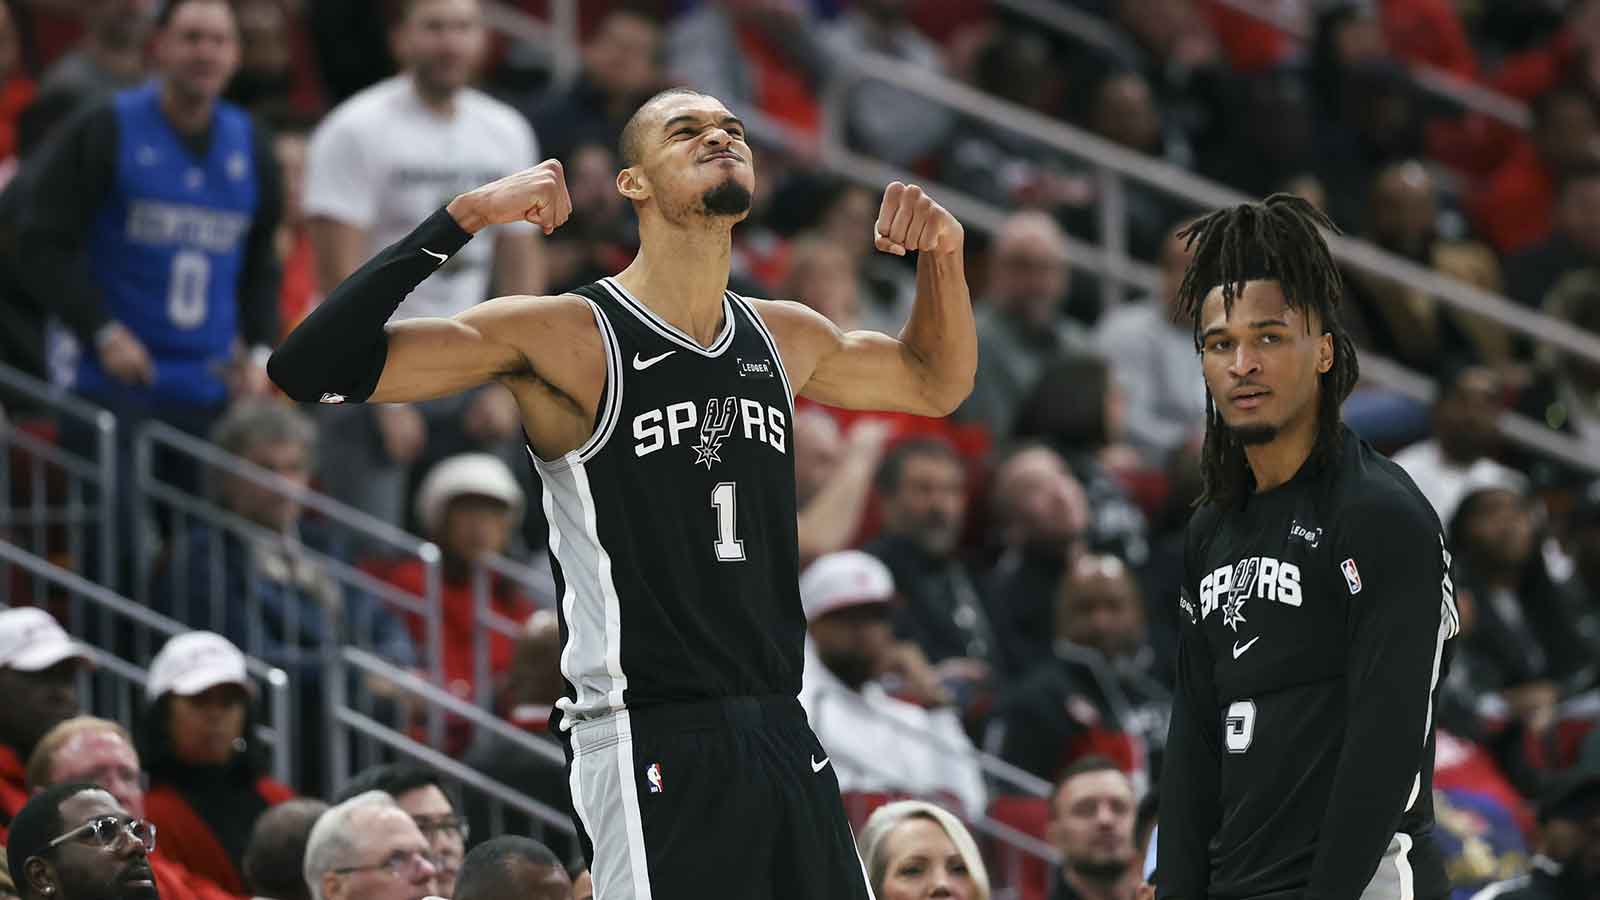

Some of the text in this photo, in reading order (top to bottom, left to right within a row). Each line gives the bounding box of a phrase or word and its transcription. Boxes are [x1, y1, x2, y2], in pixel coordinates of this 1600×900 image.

[168, 252, 211, 327] 0
[632, 397, 787, 470] SPURS
[711, 481, 747, 562] 1
[1200, 556, 1303, 632] SPURS
